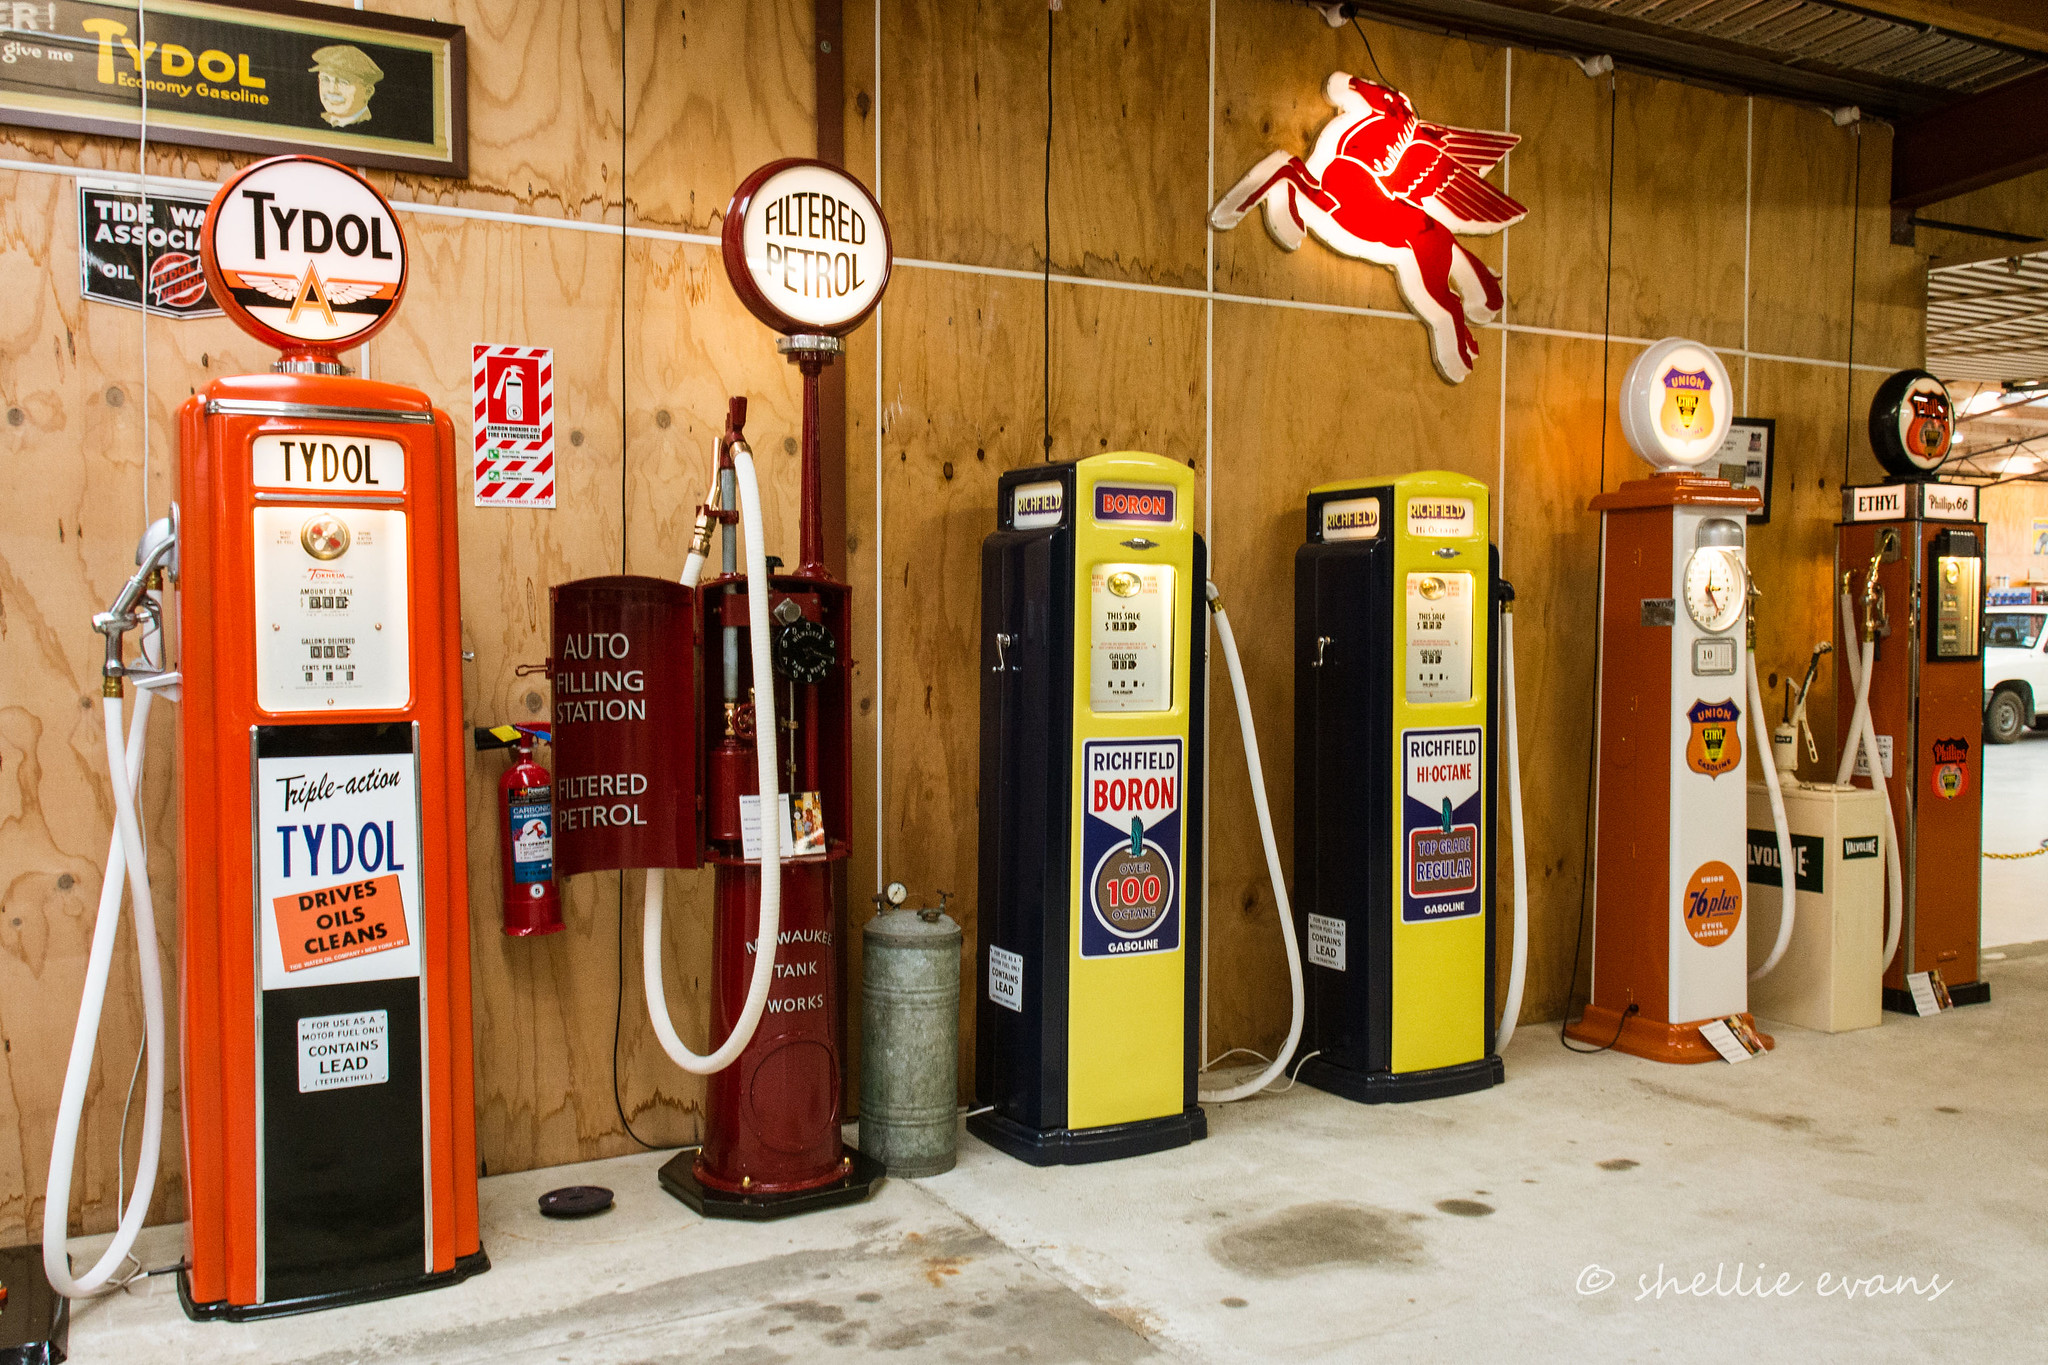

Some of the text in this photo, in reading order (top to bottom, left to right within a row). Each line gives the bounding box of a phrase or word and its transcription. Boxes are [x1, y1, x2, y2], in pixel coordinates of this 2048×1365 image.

[2, 42, 74, 63] give me
[82, 18, 266, 88] TYDOL
[117, 72, 269, 105] Economy Gasoline
[94, 199, 154, 224] TIDE
[766, 192, 866, 245] FILTERED
[243, 190, 393, 260] TYDOL
[102, 263, 135, 280] OIL
[766, 242, 865, 298] PETROL
[1671, 375, 1705, 390] UNION
[280, 441, 379, 484] TYDOL
[1017, 494, 1062, 515] RICHFIELD
[1102, 494, 1166, 516] BORON
[1409, 503, 1466, 520] RICHFIELD
[1858, 494, 1900, 512] ETHYL
[1928, 494, 1969, 513] Phillips 66
[1326, 511, 1378, 530] RICHFIELD
[300, 588, 327, 596] AMOUNT
[338, 588, 353, 596] SALE
[1106, 612, 1140, 621] THIS SALE
[1418, 613, 1446, 621] THIS SALE
[563, 632, 630, 660] AUTO
[1703, 649, 1713, 660] 10
[556, 670, 645, 695] FILLING
[556, 699, 646, 725] STATION
[1697, 708, 1732, 722] UNION
[1410, 739, 1477, 758] RICHFIELD
[1093, 751, 1175, 772] RICHFIELD
[1697, 758, 1731, 772] GASOLINE
[276, 767, 401, 812] Triple-action
[558, 774, 648, 801] FILTERED
[1093, 776, 1175, 813] BORON
[559, 804, 648, 832] PETROL
[277, 820, 405, 878] TYDOL
[1418, 836, 1471, 856] TOP GRADE
[1844, 838, 1877, 856] VALVOLINE
[1119, 861, 1151, 876] OVER
[1416, 859, 1472, 882] REGULAR
[1701, 875, 1724, 884] UNION
[298, 881, 377, 912] DRIVES
[1106, 875, 1162, 908] 100
[1111, 905, 1157, 921] OCTANE
[1424, 901, 1465, 915] GASOLINE
[1707, 888, 1739, 919] plus
[316, 906, 365, 929] OILS
[1701, 921, 1723, 931] ETHYL
[304, 923, 388, 954] CLEANS
[745, 928, 833, 955] MWAUKEE
[1311, 932, 1342, 947] CONTAINS
[1694, 928, 1729, 939] GASOLINE
[303, 958, 324, 968] WATER
[333, 951, 361, 961] COMPANY
[364, 946, 378, 954] NEW
[377, 942, 393, 951] YORK
[1108, 938, 1159, 953] GASOLINE
[1315, 943, 1337, 958] LEAD
[774, 960, 818, 979] TANK
[991, 967, 1019, 985] CONTAINS
[995, 980, 1014, 996] LEAD
[767, 994, 824, 1014] WORKS
[302, 1025, 384, 1041] MOTOR FUEL ONLY
[312, 1021, 329, 1030] FOR
[333, 1019, 350, 1028] USE
[353, 1017, 366, 1025] AS
[309, 1039, 379, 1057] CONTAINS
[320, 1056, 369, 1075] LEAD
